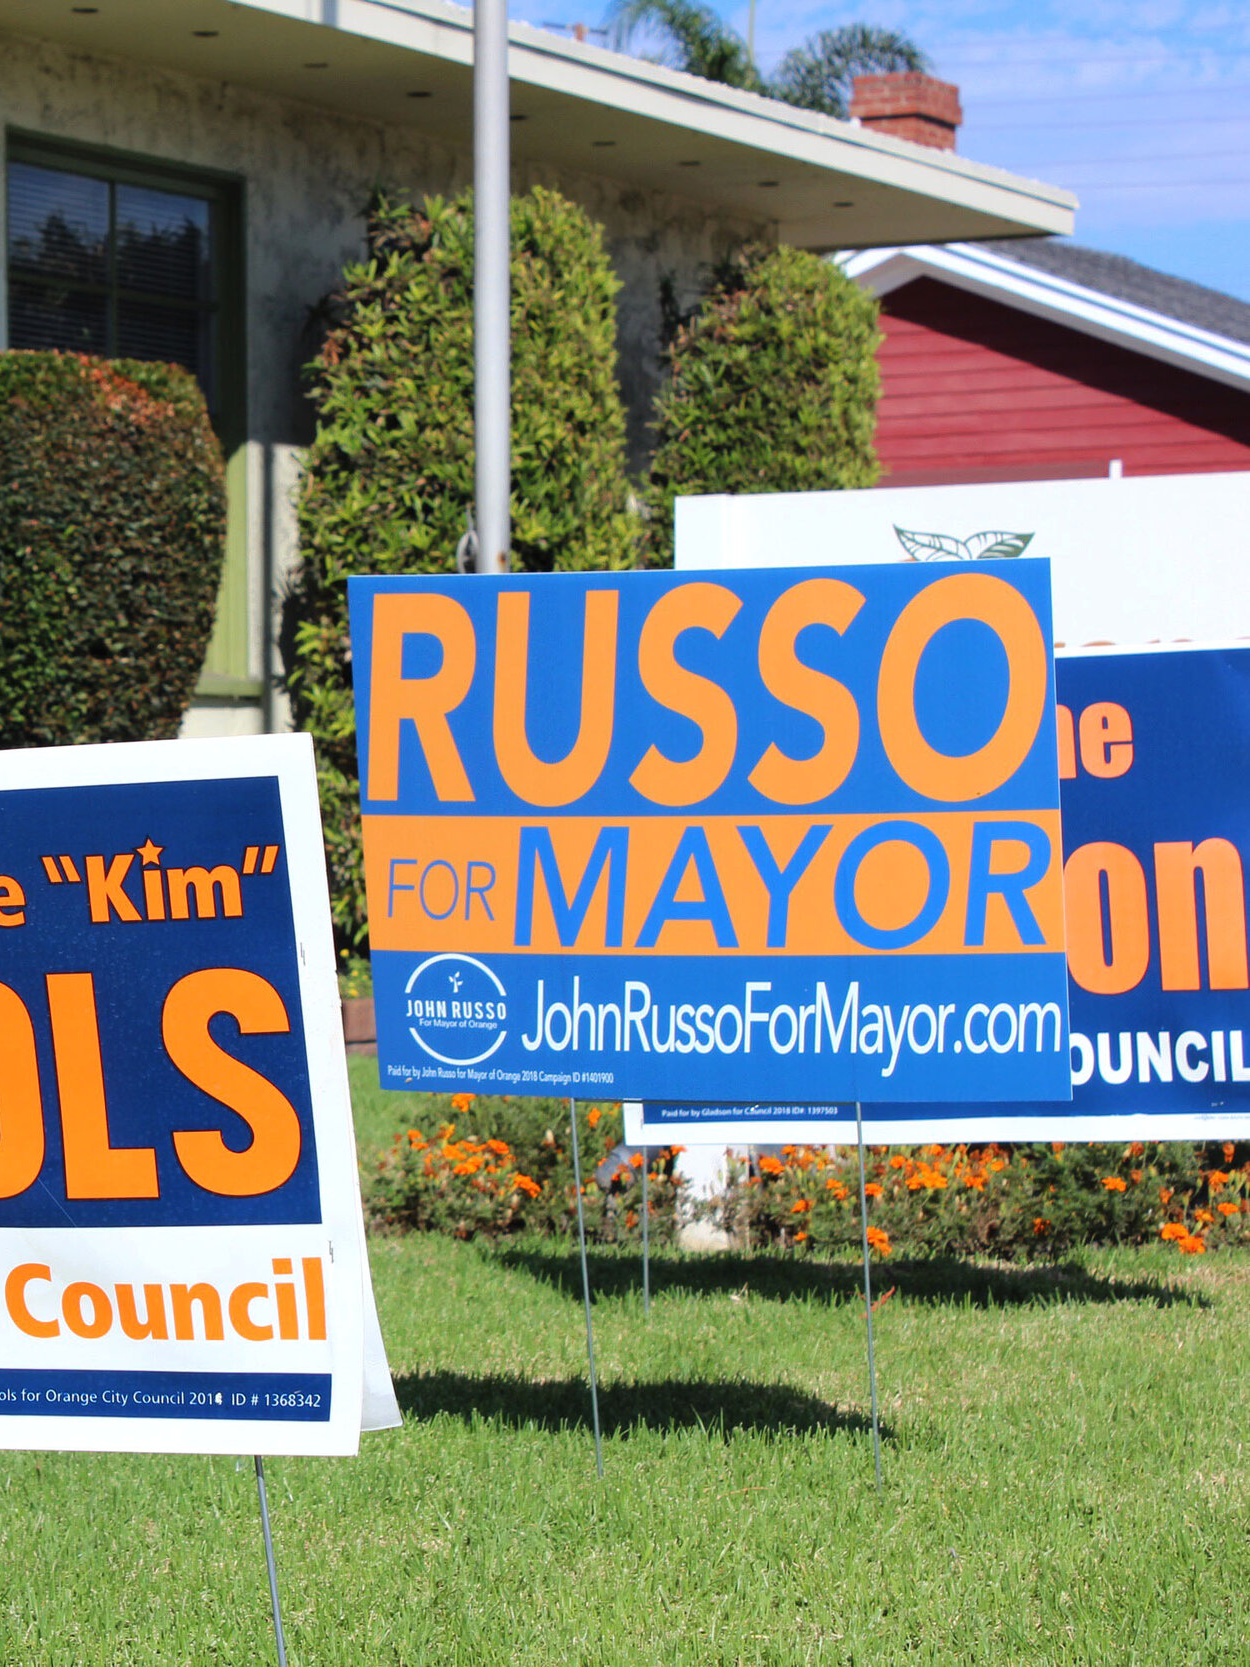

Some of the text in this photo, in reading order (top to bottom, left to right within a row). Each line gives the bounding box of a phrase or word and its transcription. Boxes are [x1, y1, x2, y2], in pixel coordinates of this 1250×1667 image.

[367, 572, 1048, 808] RUSSO
[387, 820, 1052, 950] FOR MAYOR
[406, 1000, 506, 1020] JOHN RUSSO
[419, 1018, 497, 1030] For Mayor of Orange
[522, 980, 1062, 1077] JohnRussoForMayor.com
[388, 1065, 401, 1076] Paid
[402, 1065, 411, 1077] for
[412, 1066, 421, 1079] by
[422, 1066, 437, 1078] John
[438, 1067, 456, 1078] Russo
[457, 1067, 466, 1079] for
[468, 1068, 487, 1082] Mayor
[489, 1068, 496, 1080] of
[497, 1069, 520, 1084] Orange
[522, 1070, 538, 1082] 2018
[539, 1071, 571, 1086] Campaign
[572, 1072, 581, 1083] ID
[662, 1109, 678, 1117] Paid
[679, 1108, 689, 1117] for
[691, 1109, 700, 1118] by
[701, 1107, 731, 1116] Gladson
[732, 1107, 743, 1115] for
[4, 1257, 327, 1342] Council
[21, 1389, 40, 1402] for
[45, 1390, 97, 1406] Orange
[102, 1390, 128, 1406] City
[133, 1391, 184, 1405] Council
[231, 1392, 246, 1406] ID
[251, 1393, 259, 1406] #
[264, 1393, 321, 1408] 1368342
